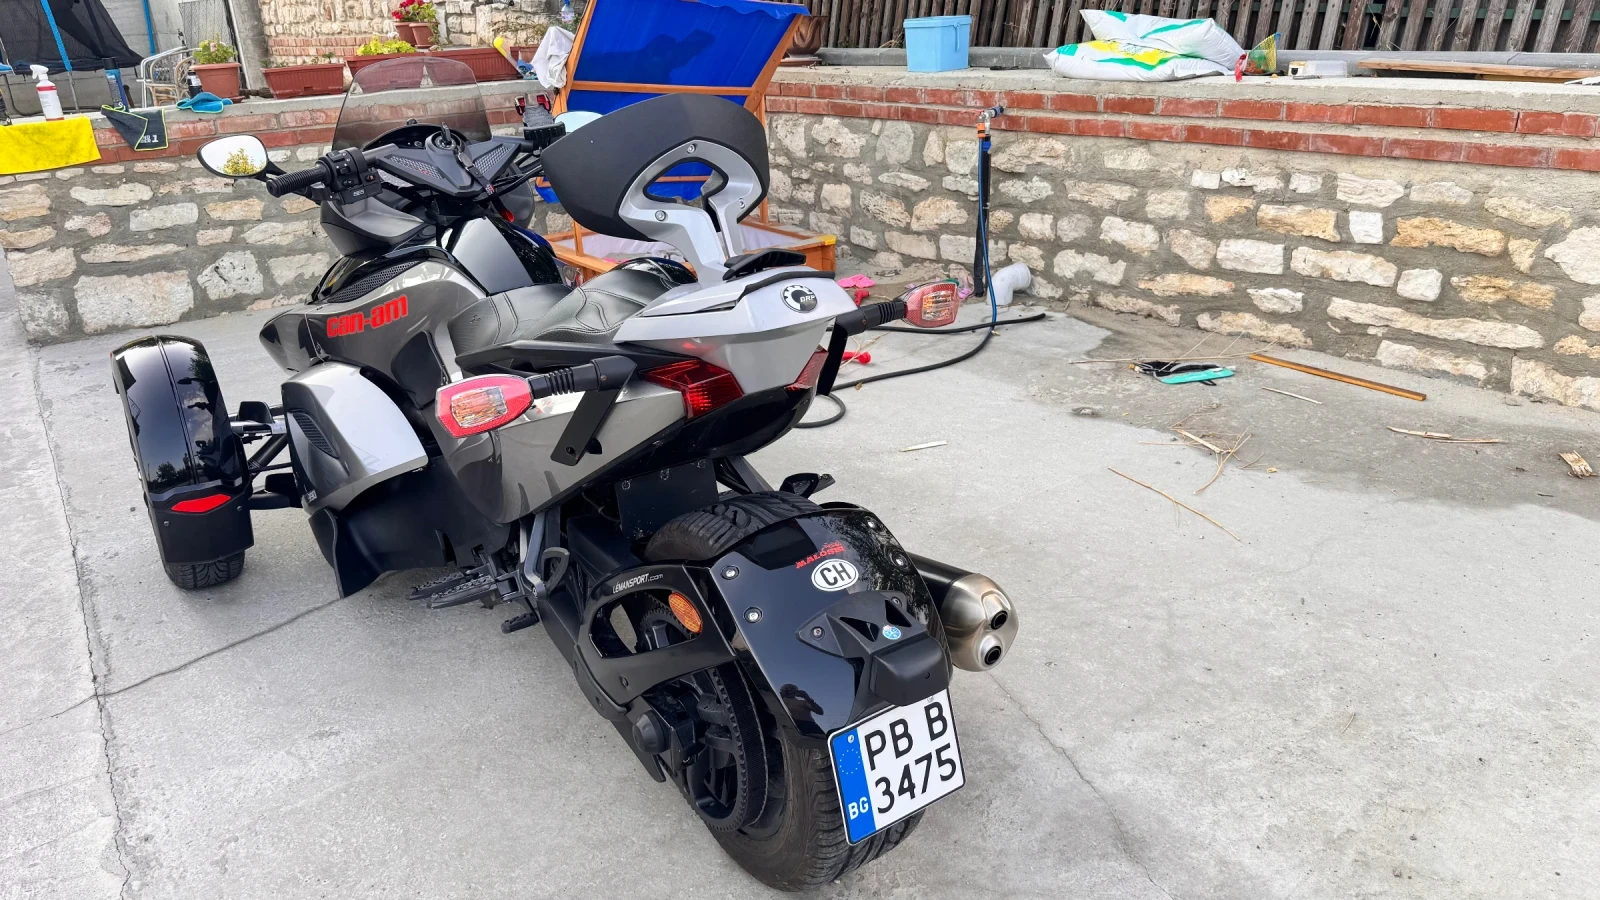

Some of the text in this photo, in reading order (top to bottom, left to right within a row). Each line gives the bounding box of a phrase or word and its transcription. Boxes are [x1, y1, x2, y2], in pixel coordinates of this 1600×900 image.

[327, 294, 408, 338] can-am
[820, 562, 852, 586] CH
[864, 701, 948, 772] PB B
[874, 742, 957, 814] 3475
[848, 796, 869, 821] BG
